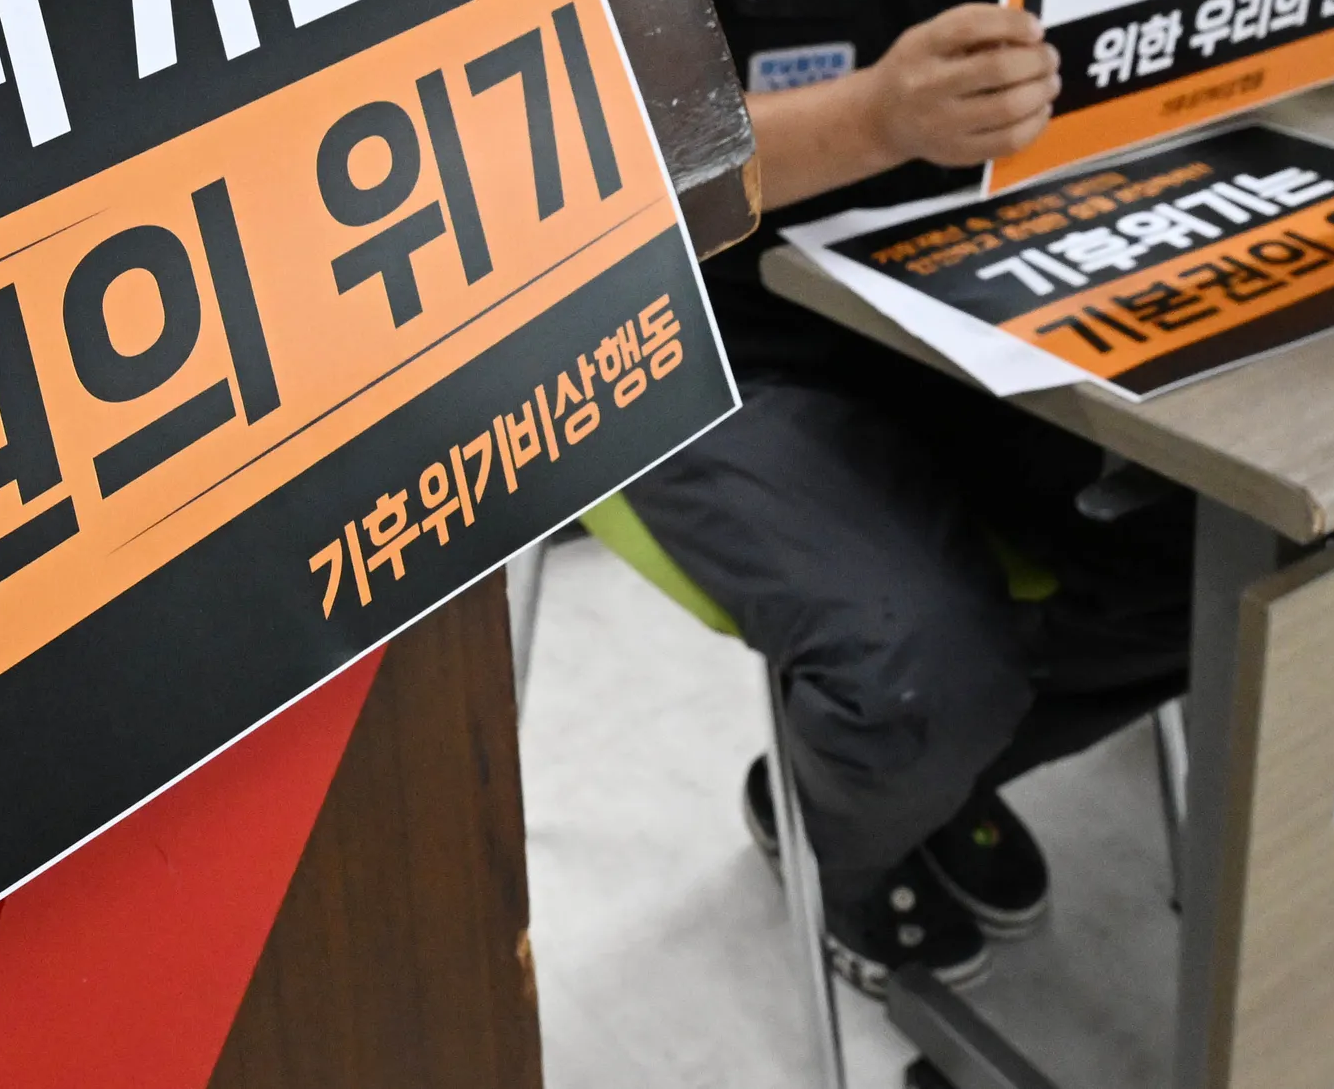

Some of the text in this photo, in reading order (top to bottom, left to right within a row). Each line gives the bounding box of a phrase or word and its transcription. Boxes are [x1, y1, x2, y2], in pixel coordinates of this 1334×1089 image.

[312, 1, 628, 330] 위기
[1087, 9, 1184, 89] 위한
[308, 293, 687, 622] 기후위기비상행동
